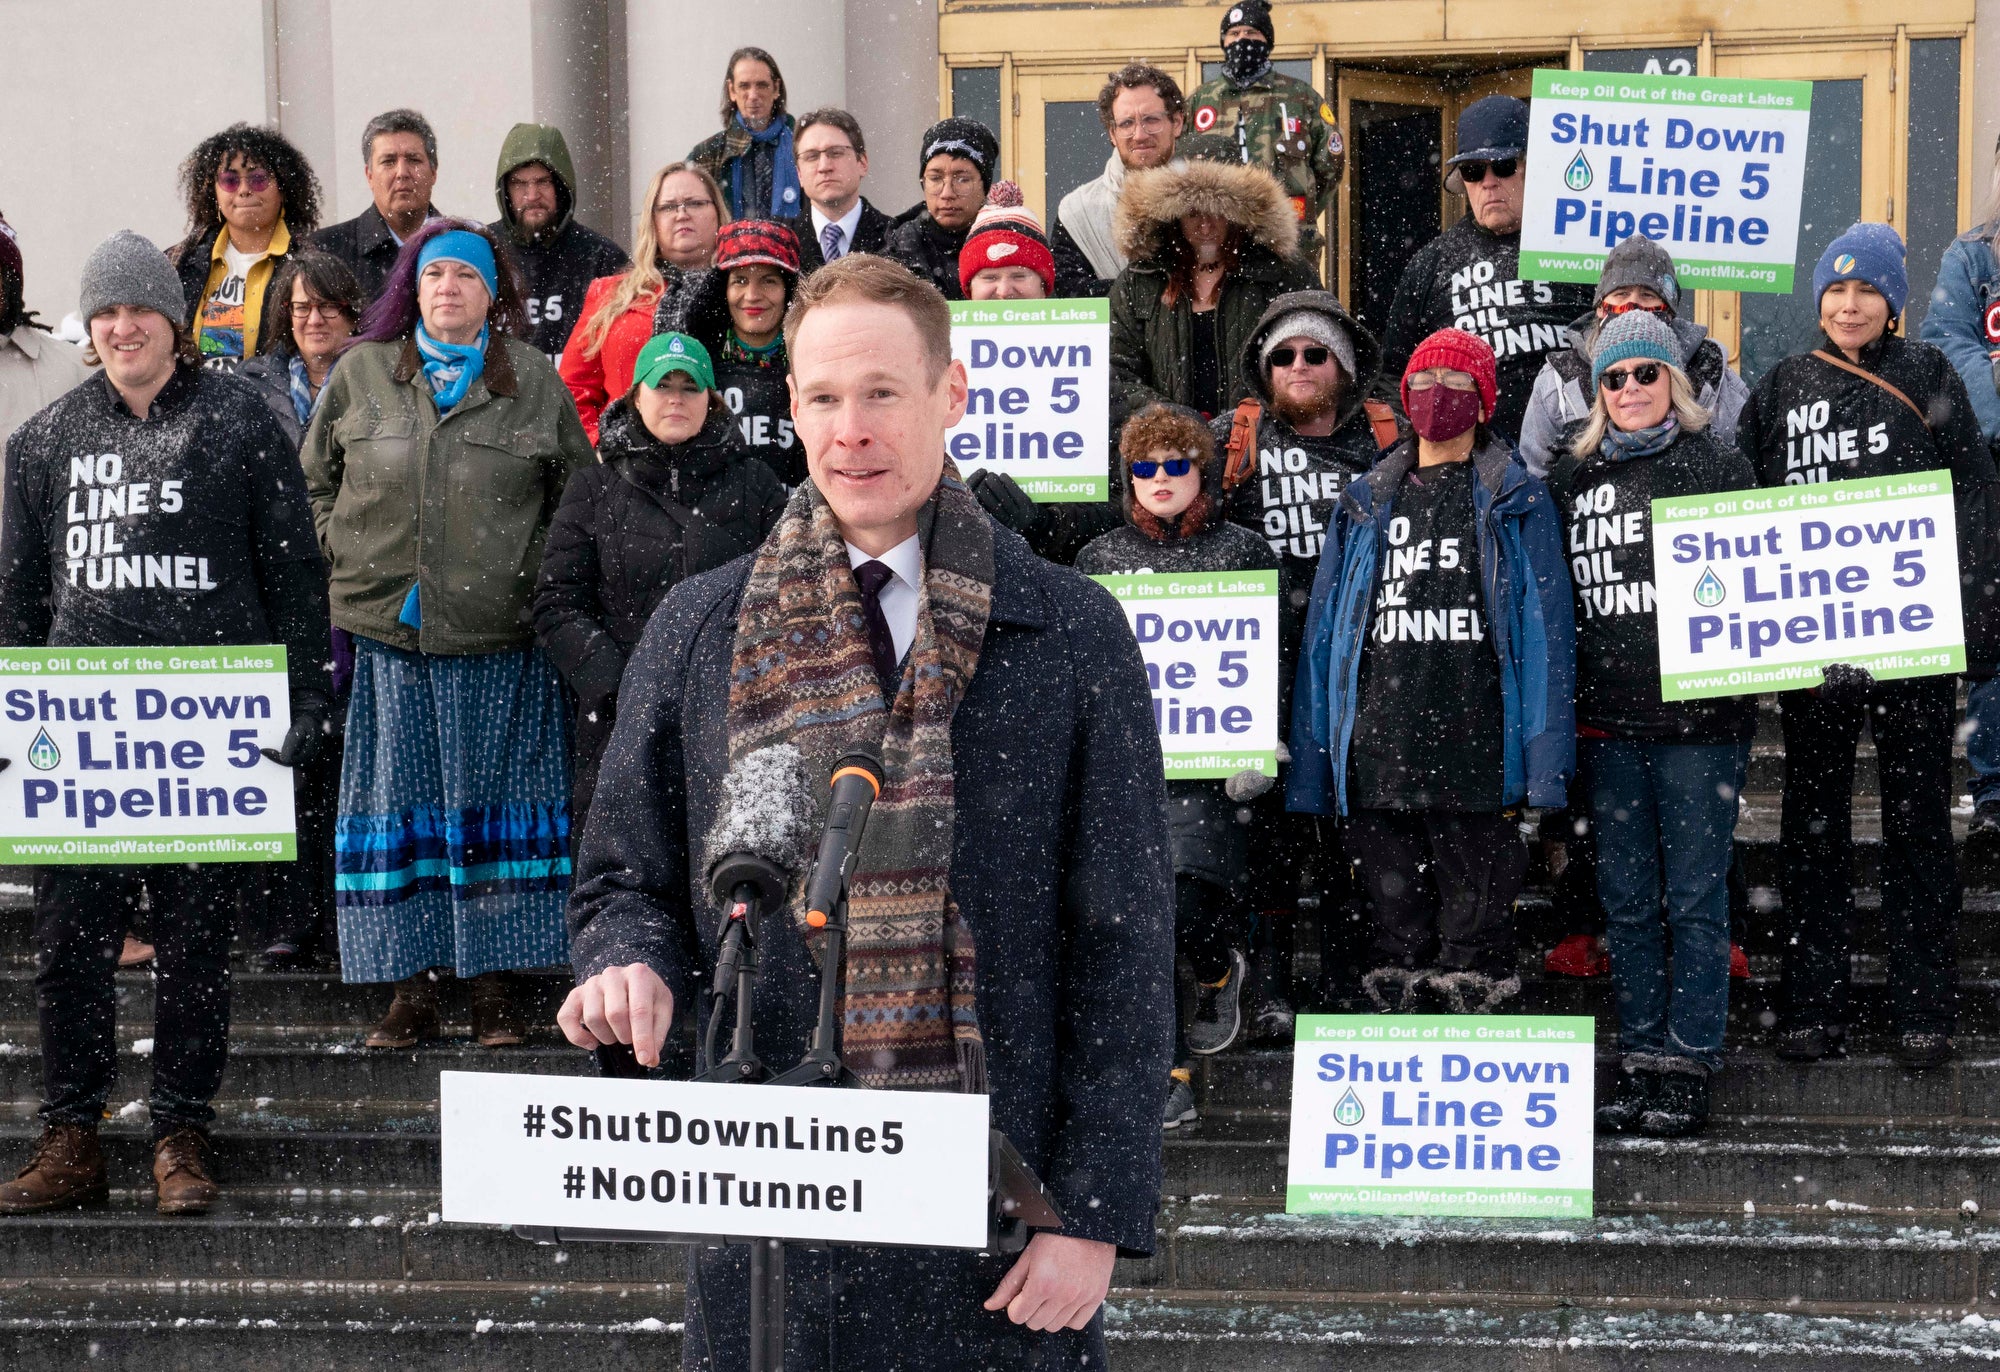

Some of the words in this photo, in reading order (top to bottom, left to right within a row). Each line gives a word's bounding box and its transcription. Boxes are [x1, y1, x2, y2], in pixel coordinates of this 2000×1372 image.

[1550, 82, 1589, 98] Keep
[1594, 84, 1615, 98] Oil
[1619, 86, 1647, 99] Out
[1651, 88, 1667, 100] of
[1671, 89, 1697, 101] the
[1700, 90, 1744, 104] Great
[1748, 91, 1794, 106] Lakes
[1551, 112, 1649, 148] Shut
[1665, 118, 1785, 154] Down
[1608, 155, 1720, 198] Line
[1739, 162, 1770, 201] 5
[1554, 197, 1770, 247] Pipeline
[1452, 261, 1494, 293] NO
[545, 295, 562, 321] 5
[1452, 279, 1525, 315] LINE
[1533, 280, 1552, 303] 5
[952, 310, 967, 322] of
[972, 310, 998, 322] the
[1002, 309, 1046, 321] Great
[1051, 309, 1097, 320] Lakes
[971, 340, 1090, 368] Down
[1482, 323, 1572, 359] UNNE
[723, 387, 743, 415] O
[967, 388, 1029, 414] ne
[1051, 378, 1079, 414] 5
[778, 419, 794, 448] 5
[1787, 400, 1830, 438] NO
[950, 423, 1083, 460] eline
[1787, 429, 1859, 471] LINE
[1868, 422, 1889, 454] 5
[71, 453, 123, 487] NO
[1260, 447, 1308, 476] NO
[67, 482, 149, 523] LINE
[159, 481, 183, 513] 5
[1262, 472, 1341, 508] LINE
[1573, 483, 1616, 519] NO
[1665, 504, 1709, 519] Keep
[1714, 502, 1737, 513] Oil
[1742, 497, 1773, 511] Out
[1777, 495, 1796, 508] of
[1800, 493, 1828, 506] the
[1833, 486, 1882, 503] Great
[1886, 481, 1938, 498] Lakes
[1263, 505, 1323, 536] OIL
[1388, 516, 1411, 546] O
[1570, 511, 1644, 554] LINE
[66, 522, 124, 558] OIL
[1672, 526, 1782, 563] Shut
[1800, 515, 1936, 551] Down
[65, 555, 218, 590] TUNNEL
[1382, 540, 1432, 581] INE
[1439, 538, 1460, 569] 5
[1572, 551, 1623, 587] OIL
[1742, 563, 1870, 604] Line
[1892, 549, 1927, 587] 5
[1116, 584, 1132, 596] of
[1138, 583, 1164, 596] the
[1168, 581, 1213, 594] Great
[1218, 580, 1266, 593] Lakes
[1578, 580, 1658, 619] TUNN
[1136, 614, 1259, 643] Down
[1688, 600, 1935, 659] Pipeline
[0, 658, 42, 674] Keep
[47, 658, 70, 671] Oil
[76, 658, 108, 670] Out
[112, 658, 130, 670] of
[135, 658, 164, 670] the
[169, 657, 217, 670] Great
[222, 656, 274, 669] Lakes
[1217, 650, 1249, 688] 5
[6, 690, 116, 721] Shut
[136, 689, 270, 720] Down
[77, 732, 204, 770] Line
[228, 730, 260, 768] 5
[23, 778, 266, 828] Pipeline
[12, 839, 283, 854] www.OilandWaterDontMix.org
[1315, 1026, 1356, 1039] Keep
[1361, 1026, 1384, 1038] Oil
[1389, 1026, 1418, 1038] Out
[1422, 1026, 1439, 1039] of
[1443, 1026, 1471, 1039] the
[1476, 1026, 1522, 1039] Great
[1527, 1026, 1576, 1040] Lakes
[1317, 1053, 1423, 1083] Shut
[1441, 1054, 1569, 1084] Down
[1382, 1091, 1503, 1127] Line
[1525, 1092, 1557, 1128] 5
[524, 1105, 903, 1154] #ShutDownLine5
[1324, 1133, 1561, 1179] Pipeline
[564, 1166, 861, 1212] #NoOilTunnel
